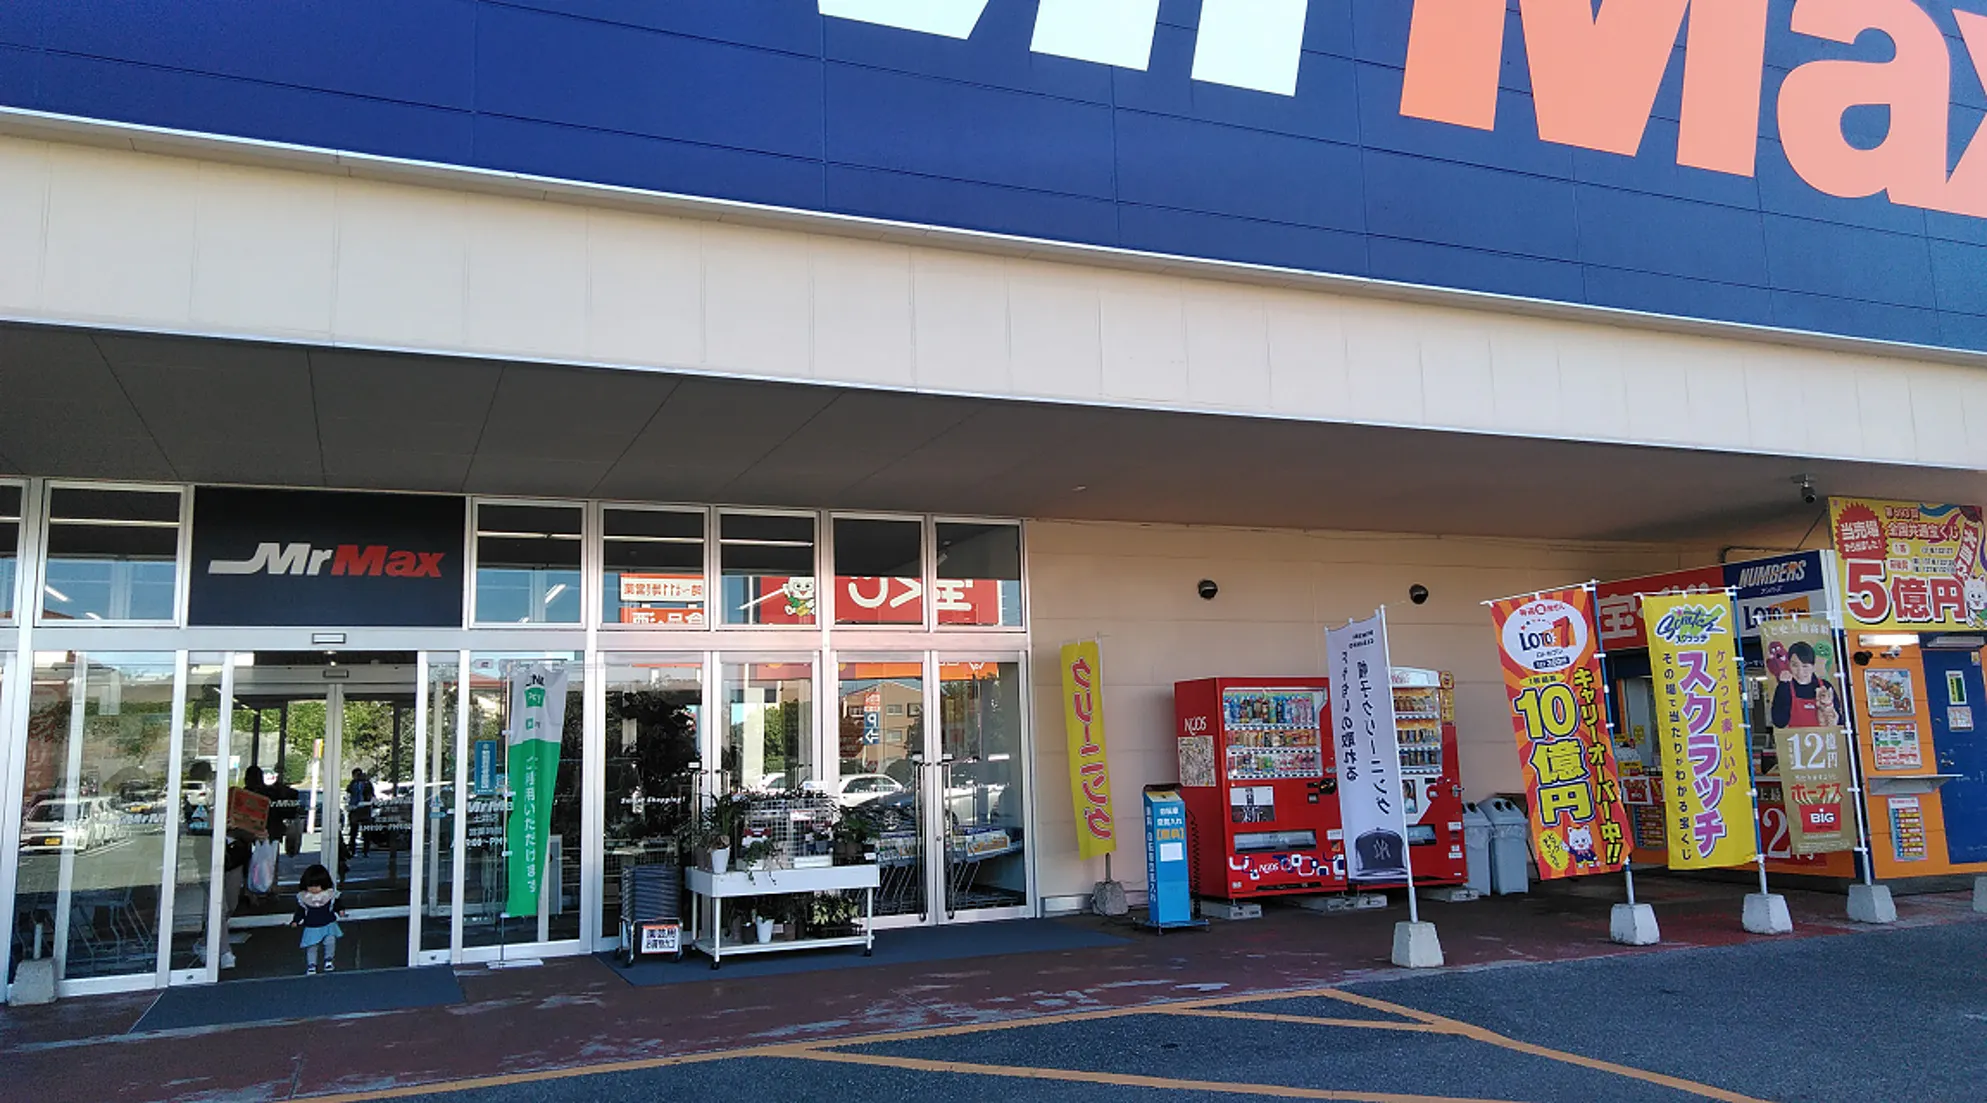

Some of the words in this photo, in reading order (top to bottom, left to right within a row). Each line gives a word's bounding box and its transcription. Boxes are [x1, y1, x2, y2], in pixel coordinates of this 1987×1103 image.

[208, 542, 445, 578] MrMax
[1738, 559, 1806, 589] NUMBERS
[1846, 559, 1970, 625] 5億円
[1514, 683, 1595, 827] 10億円
[1677, 650, 1727, 860] スクラッチ
